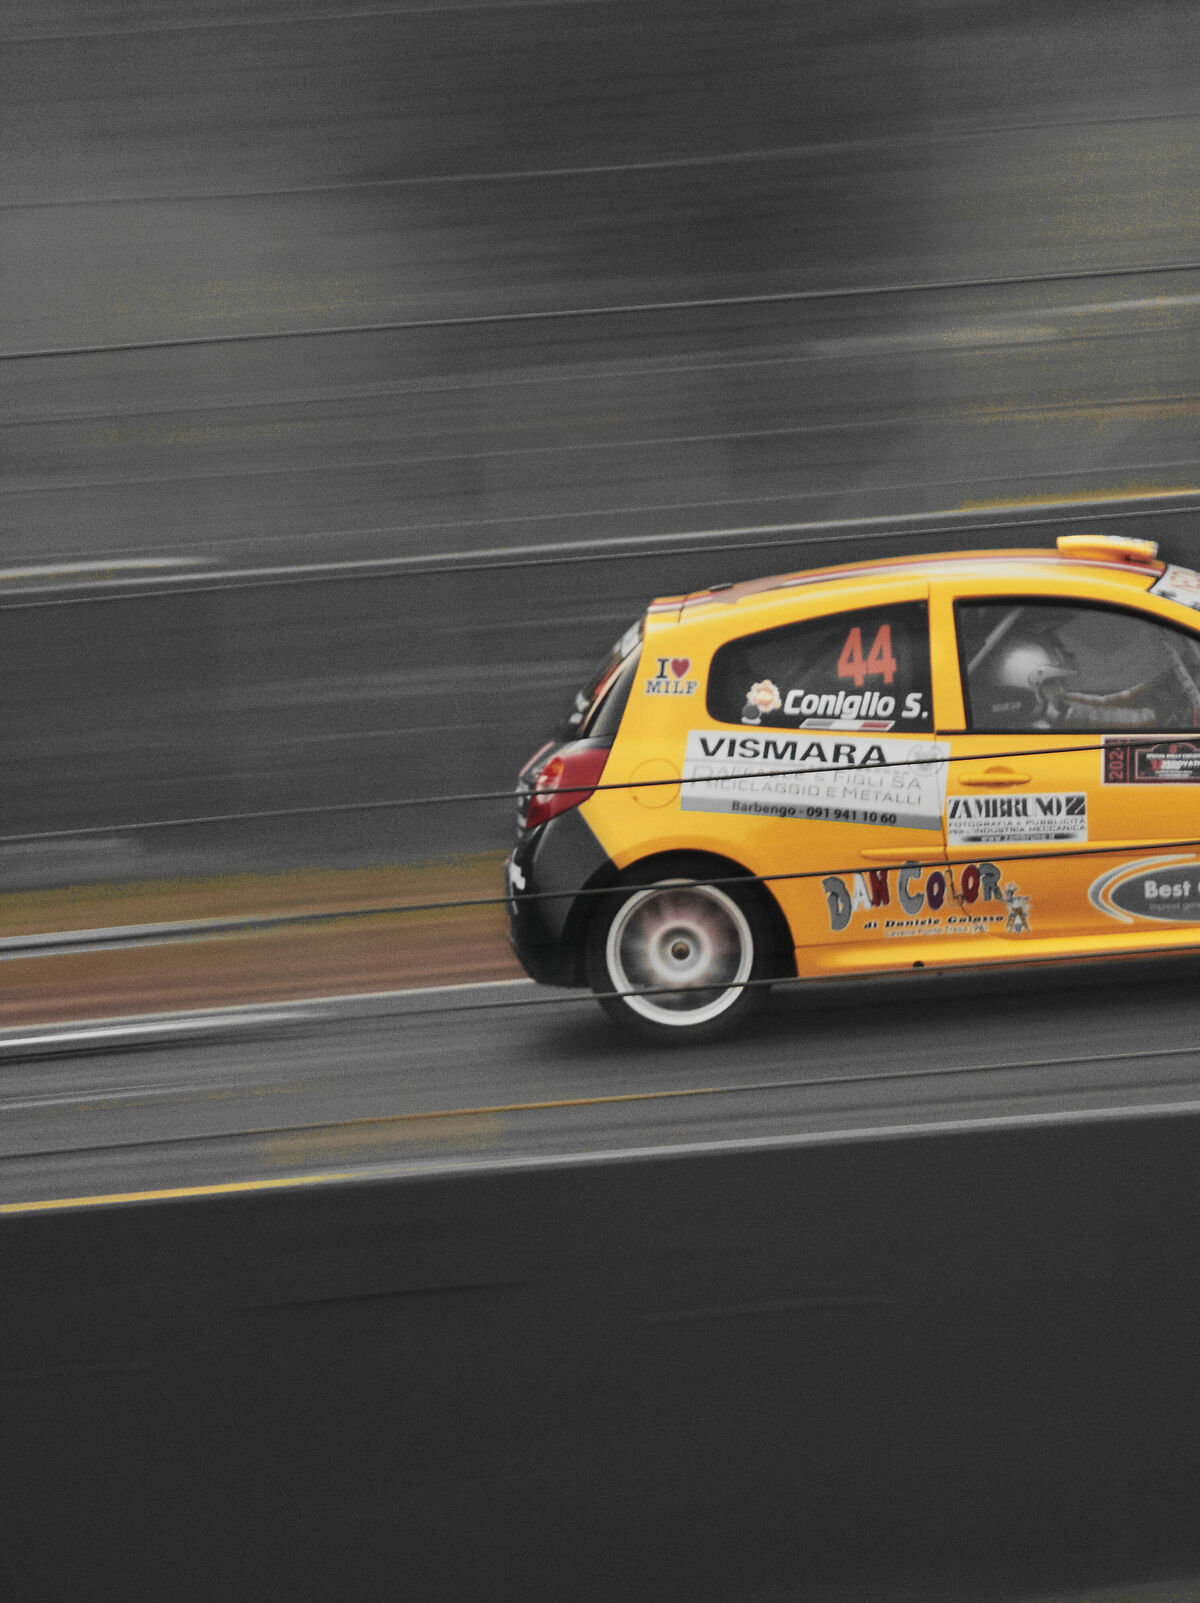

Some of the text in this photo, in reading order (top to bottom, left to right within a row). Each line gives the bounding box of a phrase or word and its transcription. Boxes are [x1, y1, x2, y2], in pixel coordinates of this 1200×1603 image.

[837, 624, 897, 687] 44
[656, 658, 670, 679] I
[645, 679, 697, 695] MILF
[784, 689, 929, 720] Coniglio S.
[700, 737, 887, 766] VISMARA
[892, 775, 922, 791] SA
[826, 786, 837, 798] E
[842, 786, 922, 805] METALLI
[731, 800, 796, 818] Barbengo
[806, 806, 830, 819] 091
[833, 808, 857, 821] 941
[863, 811, 877, 823] 10
[880, 812, 897, 824] 60
[948, 797, 1062, 819] ZAMBRUNO
[948, 820, 1013, 828] FOTOGRAFIA
[1029, 824, 1085, 832] MECCANICA
[897, 860, 1004, 917] COLOR
[1144, 879, 1192, 899] Best
[863, 921, 878, 930] di
[885, 916, 940, 928] Daniele
